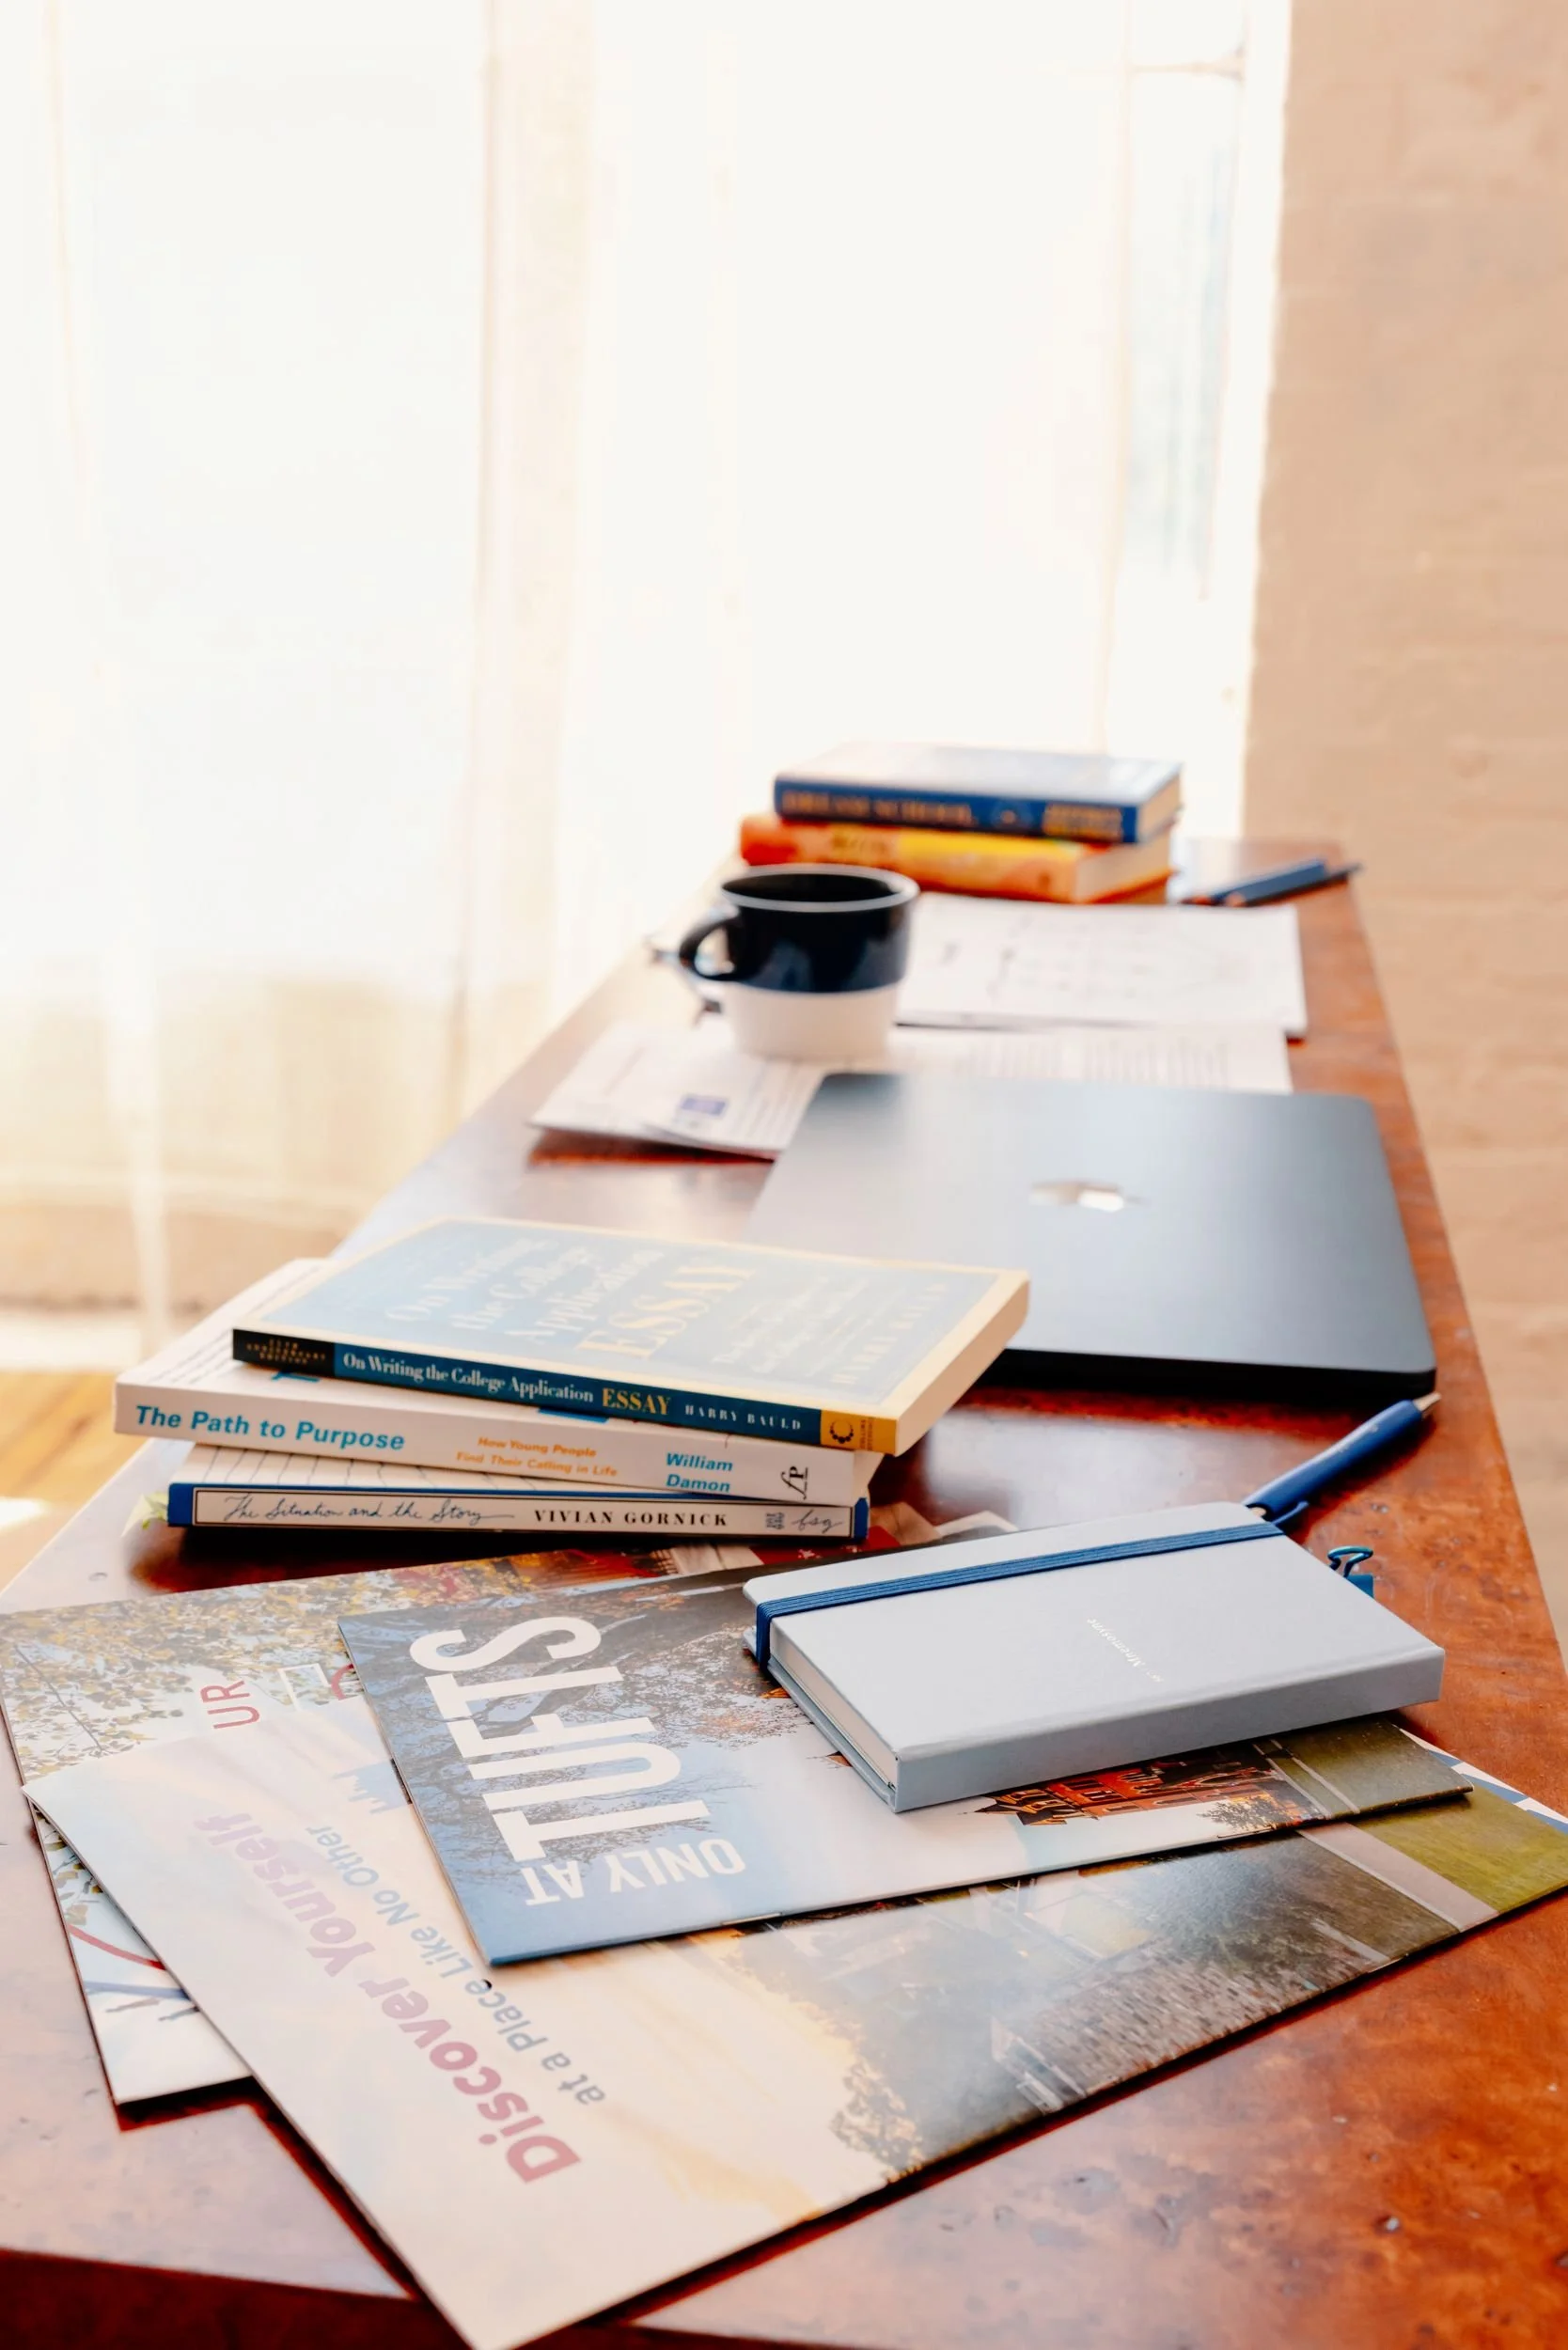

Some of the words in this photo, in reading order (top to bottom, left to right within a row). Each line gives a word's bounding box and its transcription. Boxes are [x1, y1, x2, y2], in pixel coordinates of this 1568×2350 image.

[574, 1264, 756, 1359] ESSAY
[343, 1353, 365, 1370] On
[368, 1355, 423, 1383] Writing
[426, 1364, 449, 1381] the
[451, 1368, 505, 1393] College
[509, 1376, 594, 1402] Application
[602, 1387, 670, 1415] ESSAY
[136, 1405, 181, 1428] The
[191, 1410, 249, 1434] Path
[259, 1420, 286, 1438] to
[295, 1420, 405, 1450] Purpose
[685, 1404, 737, 1421] HARRY
[747, 1413, 801, 1430] BAULD
[456, 1451, 485, 1464] Find
[491, 1454, 522, 1466] Their
[526, 1459, 572, 1474] Calling
[576, 1464, 588, 1474] in
[592, 1465, 618, 1476] Life
[478, 1437, 507, 1449] How
[510, 1439, 548, 1454] Young
[553, 1444, 596, 1457] People
[666, 1452, 733, 1472] William
[666, 1473, 731, 1493] Damon
[224, 1494, 259, 1521] The
[265, 1498, 344, 1520] Situation
[349, 1503, 382, 1517] and
[387, 1503, 423, 1519] the
[429, 1498, 514, 1527] Story
[535, 1510, 613, 1525] VIVIAN
[624, 1512, 727, 1527] GORNICK
[409, 1616, 711, 1863] TUFTS
[306, 1826, 379, 1887] Other
[609, 1838, 746, 1893] ONLY
[194, 1813, 375, 1977] Yourself
[514, 1859, 594, 1905] AT
[372, 1889, 420, 1925] No
[410, 1925, 473, 1978] Like
[464, 1981, 548, 2051] Place
[358, 1978, 581, 2183] Discover
[541, 2053, 571, 2072] a
[557, 2074, 605, 2105] at
